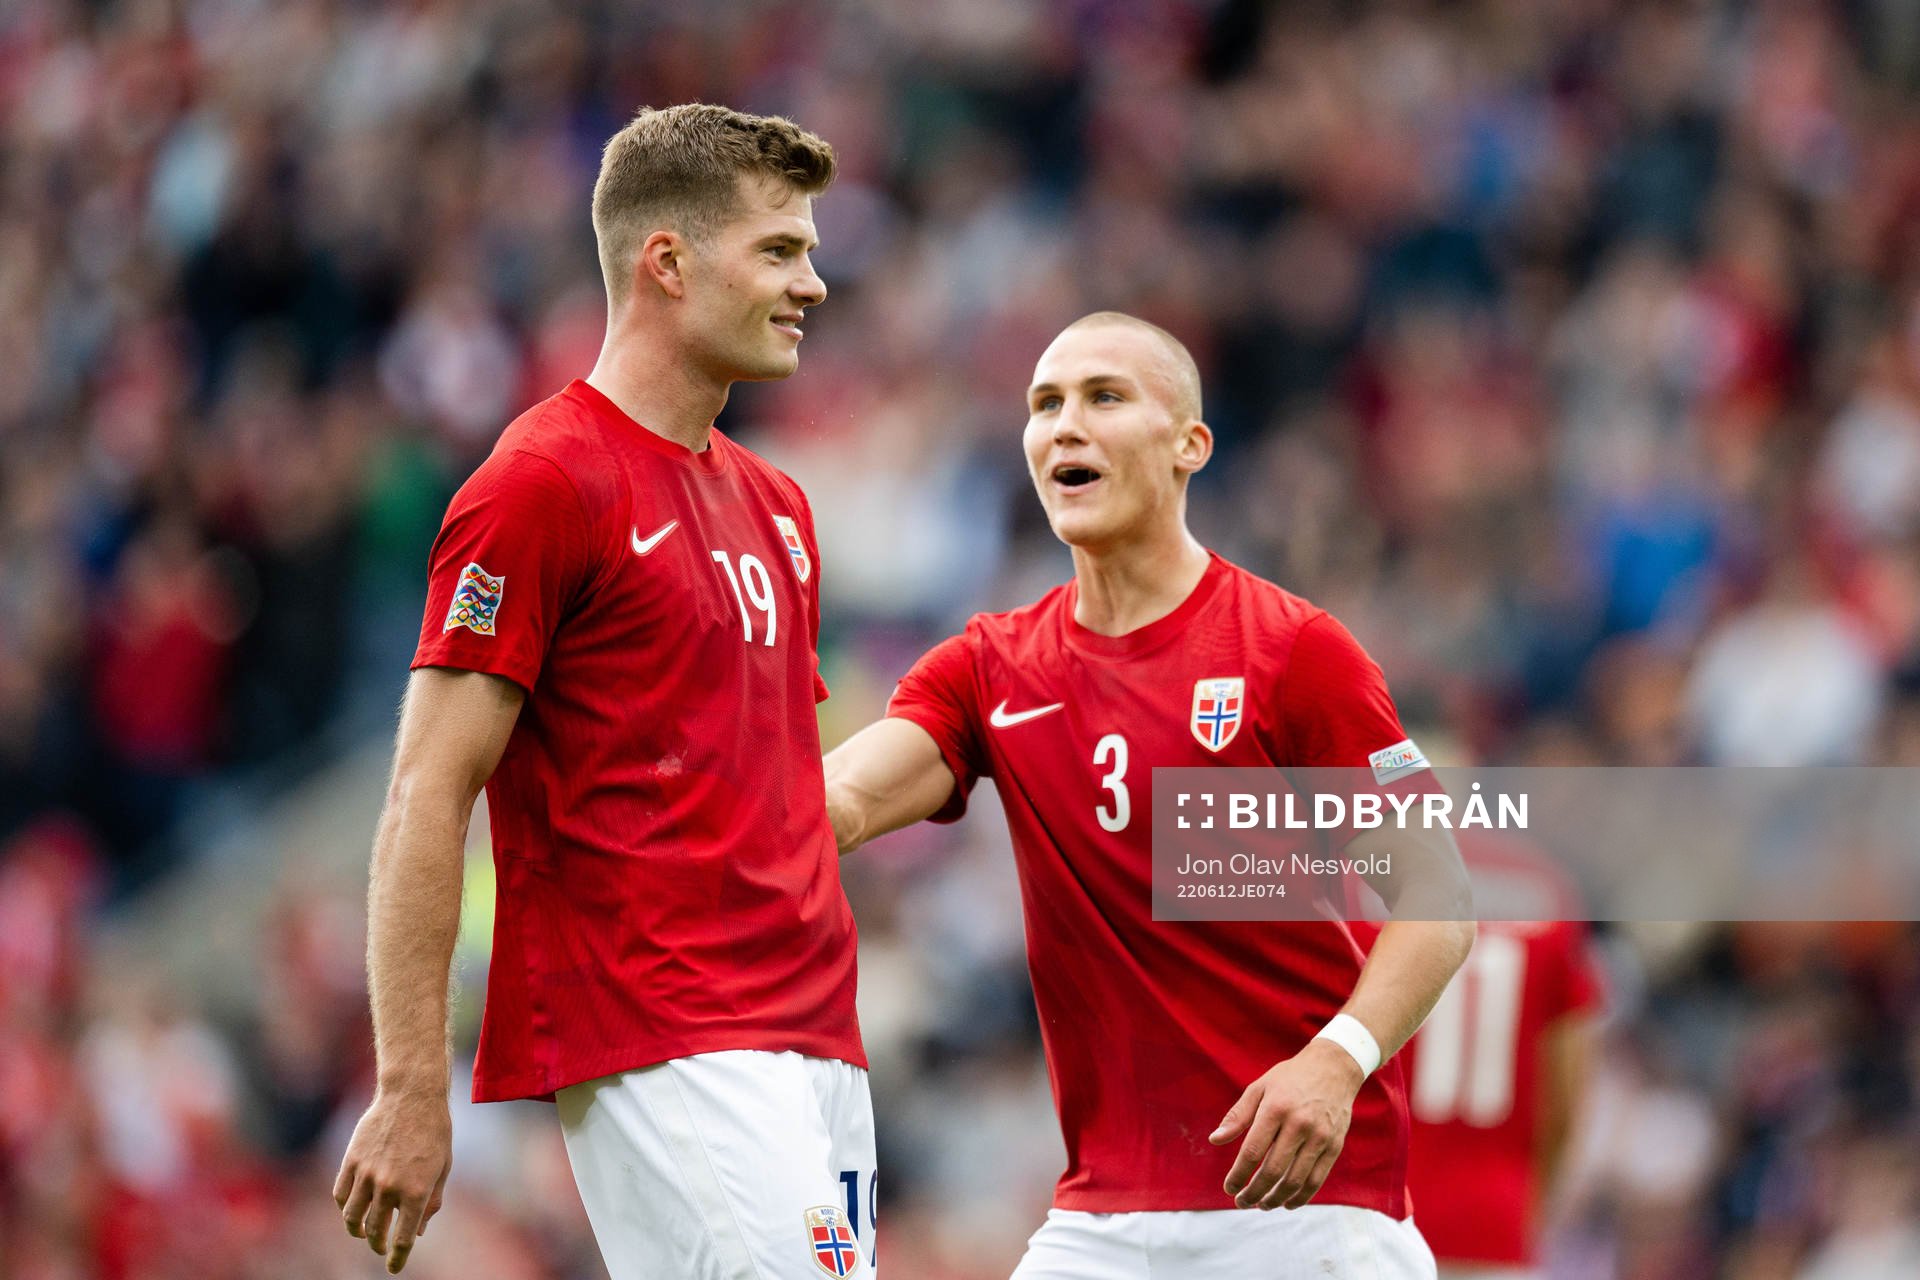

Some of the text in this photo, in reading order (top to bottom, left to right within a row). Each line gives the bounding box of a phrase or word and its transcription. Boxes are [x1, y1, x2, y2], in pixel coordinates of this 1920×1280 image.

[711, 550, 777, 647] 19
[1093, 733, 1131, 833] 3
[1374, 751, 1417, 771] FOUN
